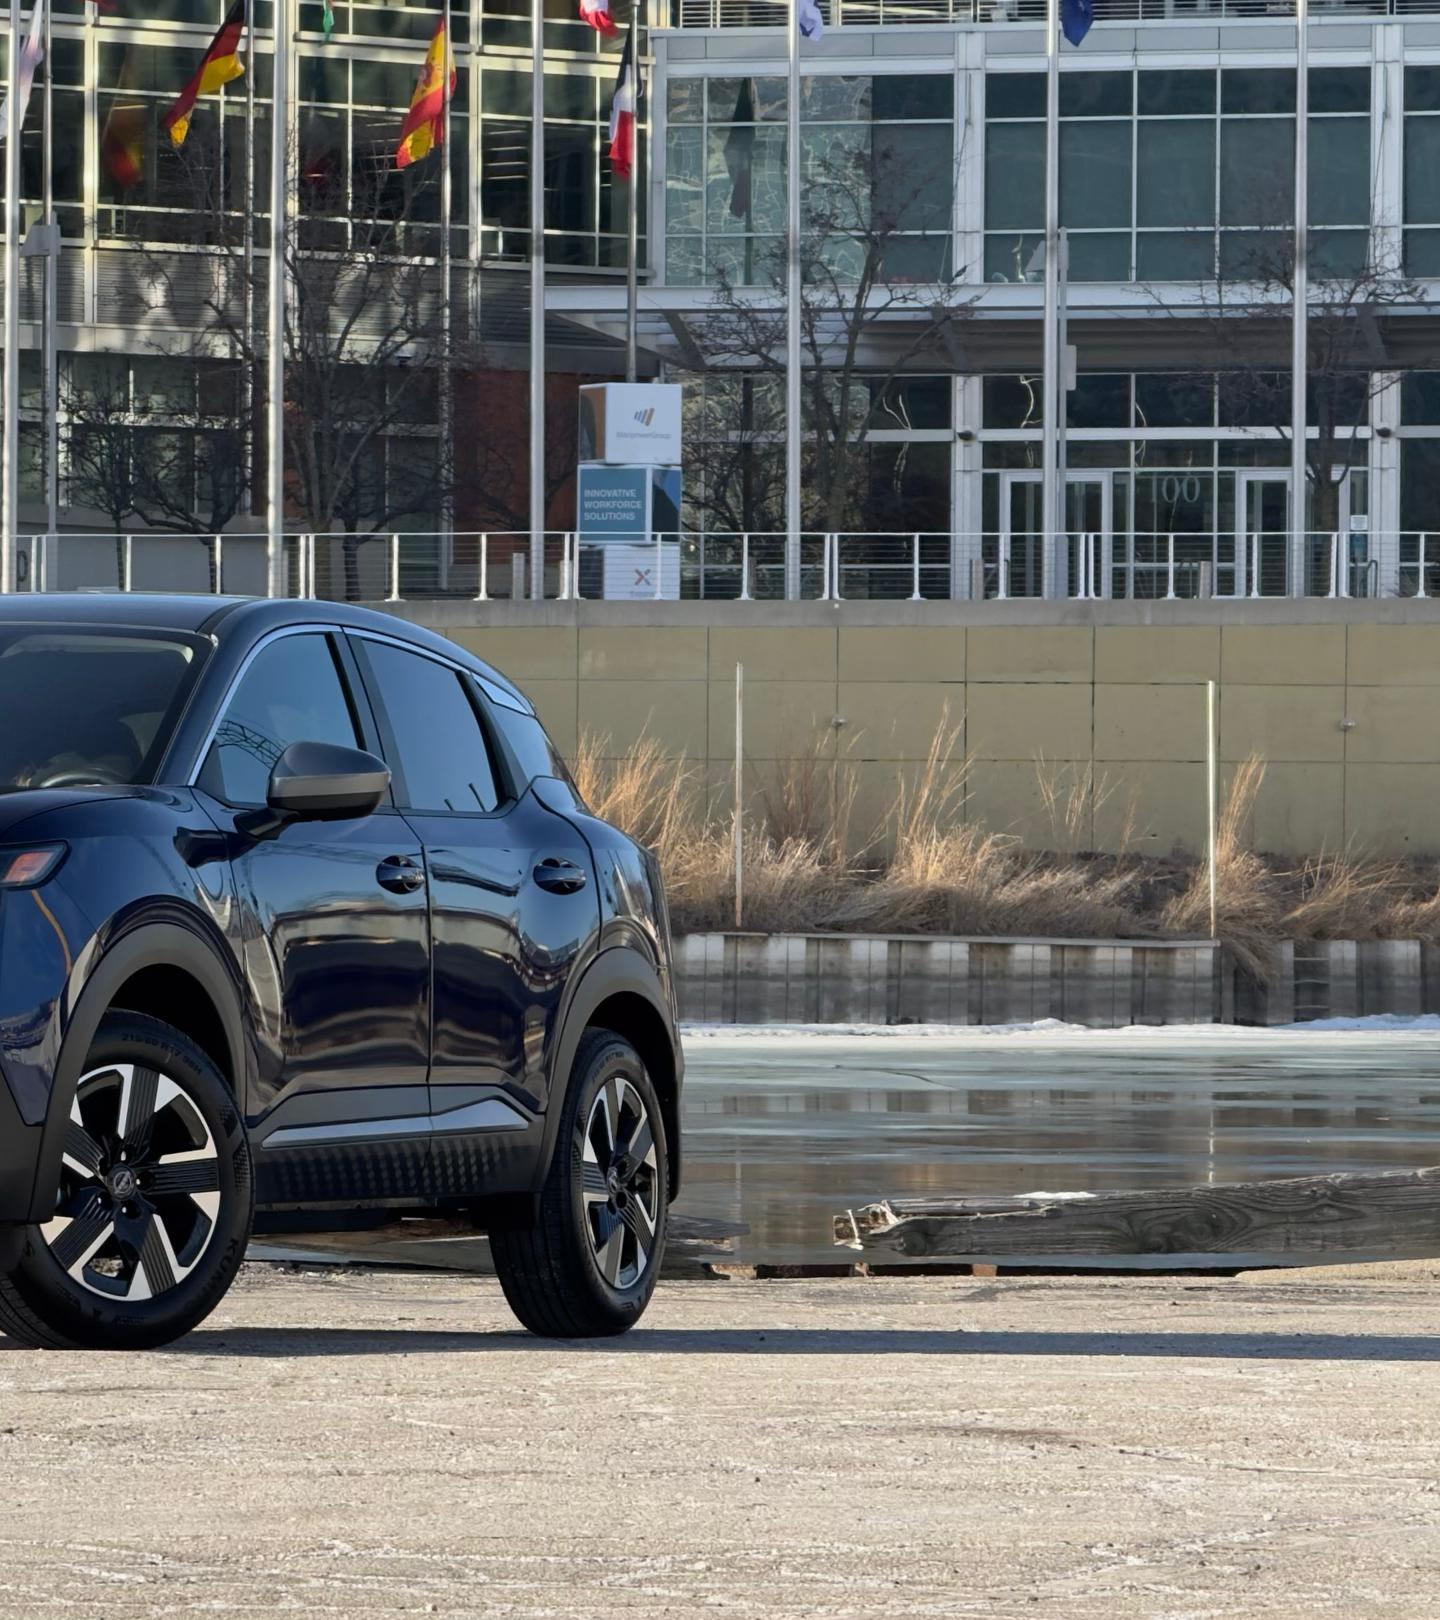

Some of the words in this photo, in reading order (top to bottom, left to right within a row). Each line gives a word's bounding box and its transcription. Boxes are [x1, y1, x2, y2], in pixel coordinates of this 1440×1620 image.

[584, 489, 637, 498] INNOVATIVE
[1150, 475, 1201, 503] 100
[584, 500, 642, 509] WORKFORCE
[584, 512, 636, 521] SOLUTIONS
